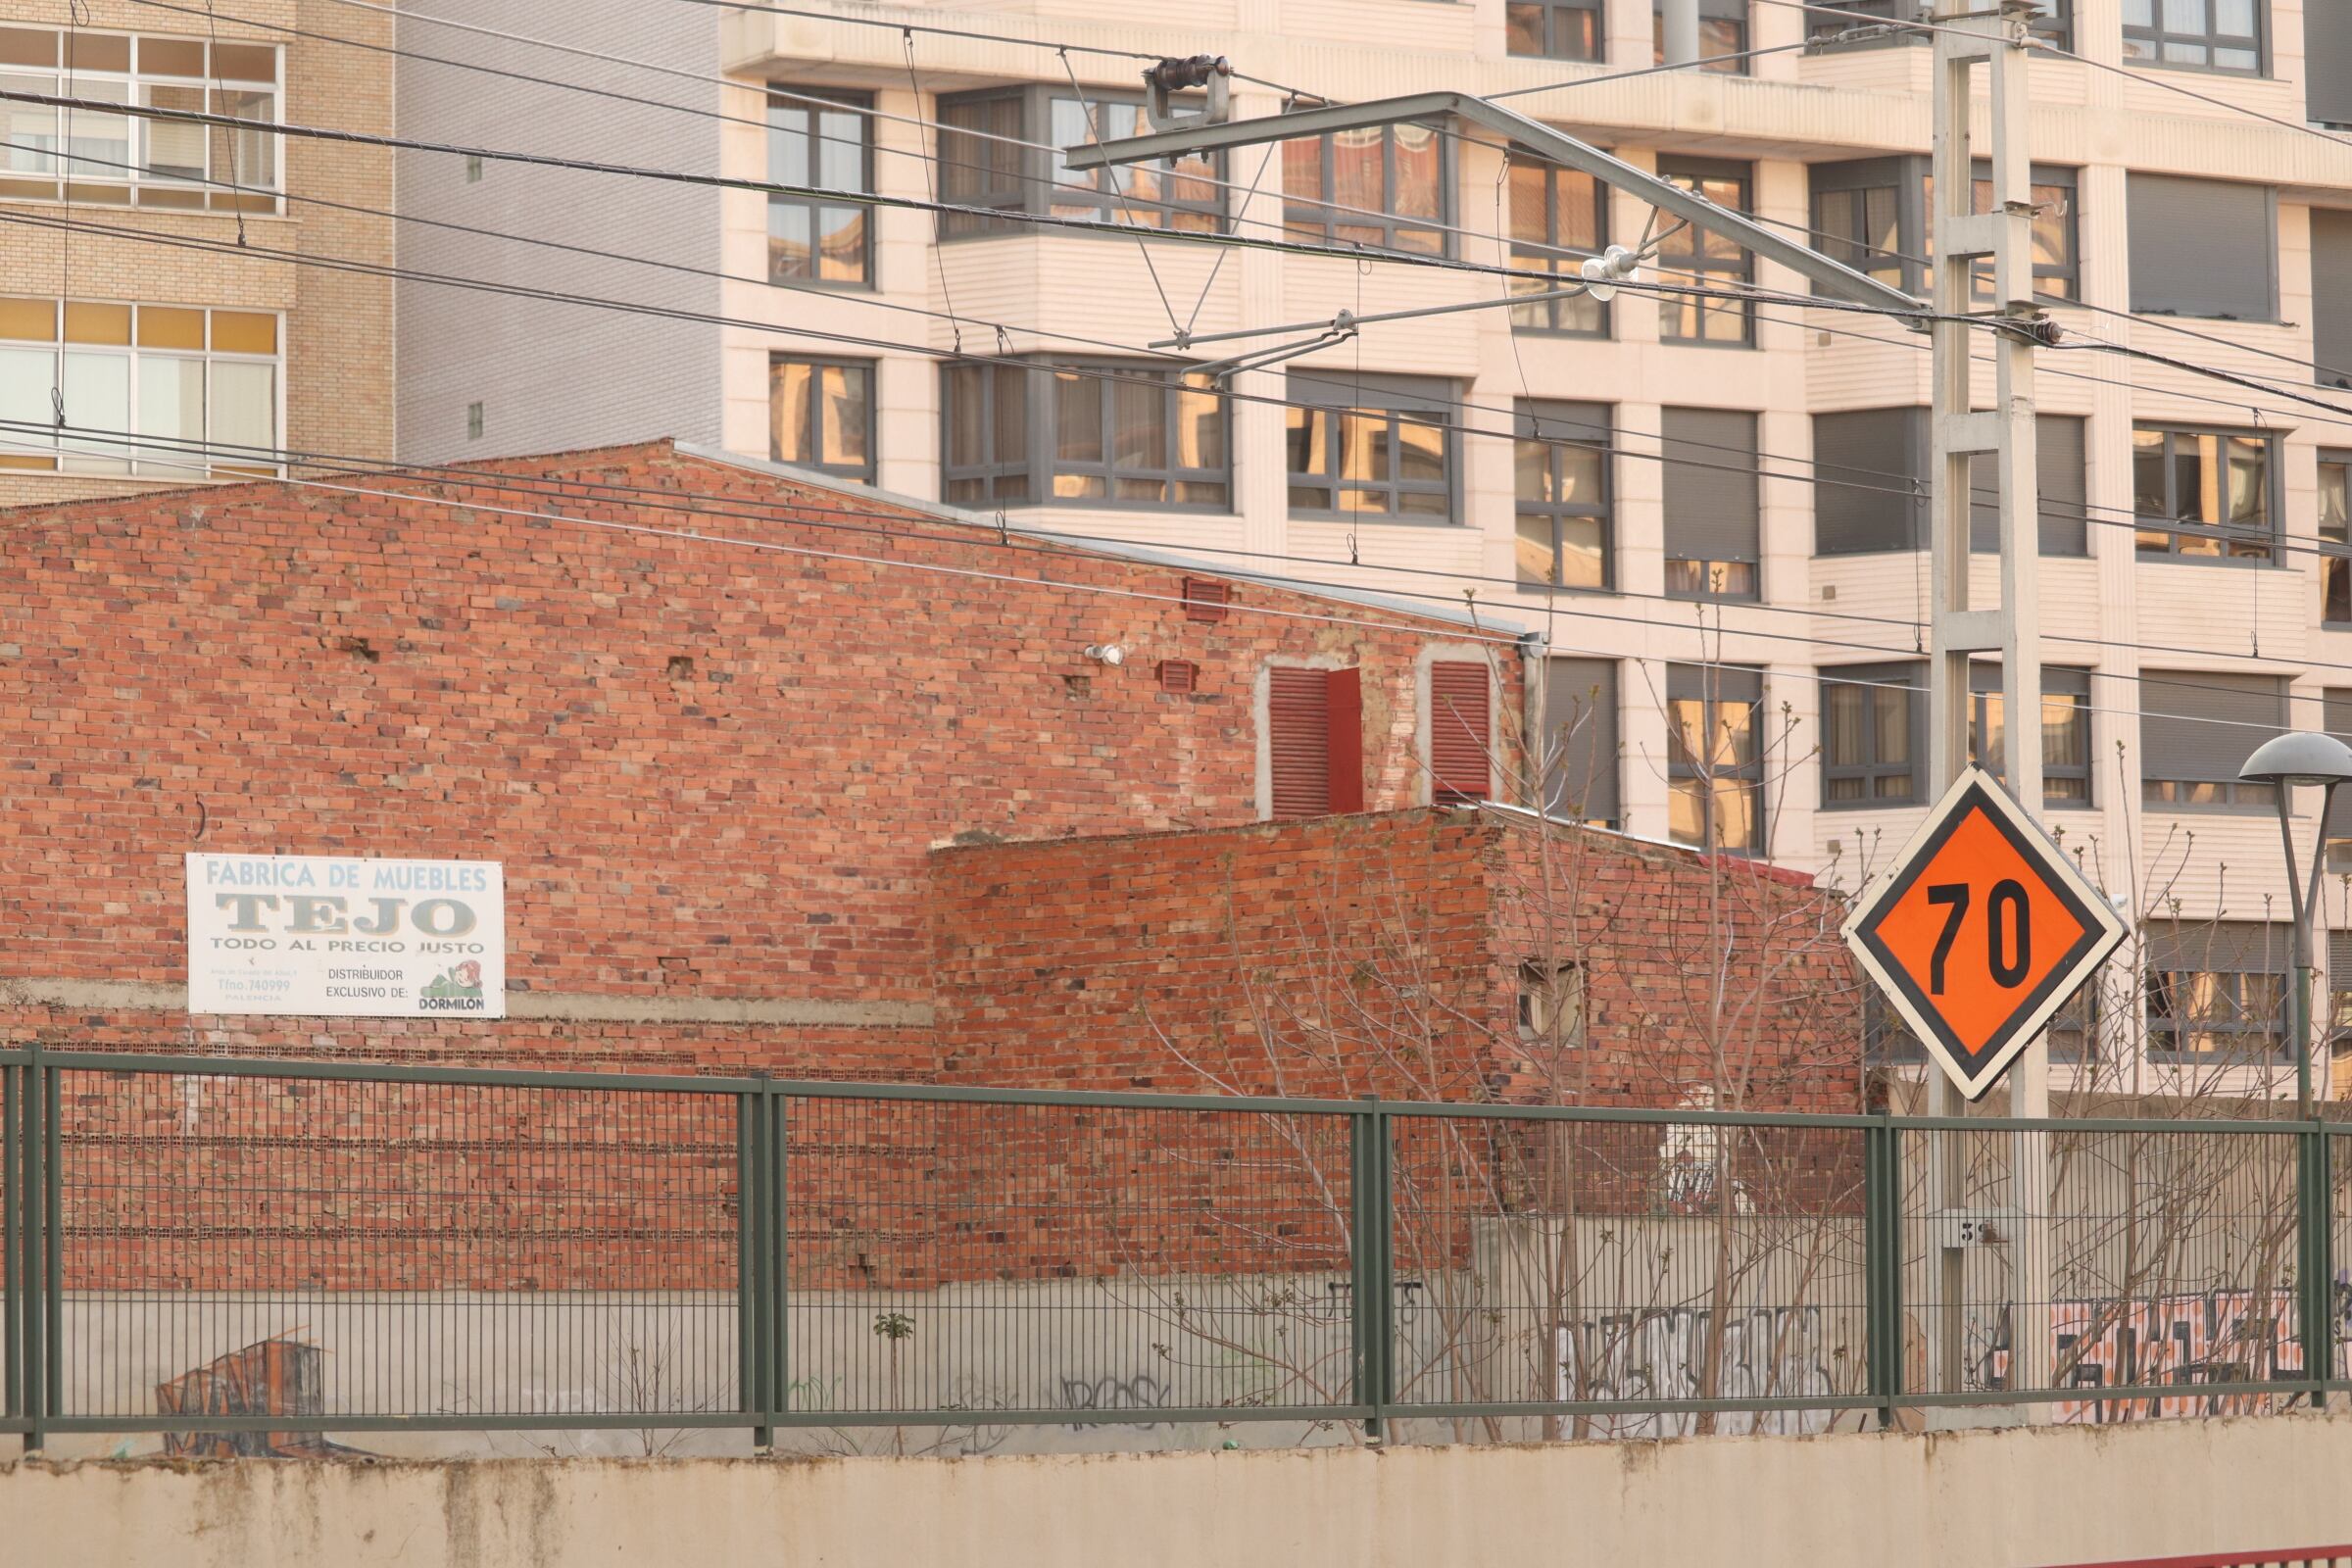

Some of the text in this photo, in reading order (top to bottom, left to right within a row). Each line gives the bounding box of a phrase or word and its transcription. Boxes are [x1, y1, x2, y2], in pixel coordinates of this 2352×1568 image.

[207, 860, 487, 892] FABRICA DE MUEBLES
[216, 893, 477, 938] TEJO
[210, 937, 484, 954] TODO AL PRECIO JUSTO
[1927, 878, 2032, 996] 70
[328, 968, 403, 980] DISTRIBUIDOR
[325, 986, 409, 999] EXCLUSIVO DE:
